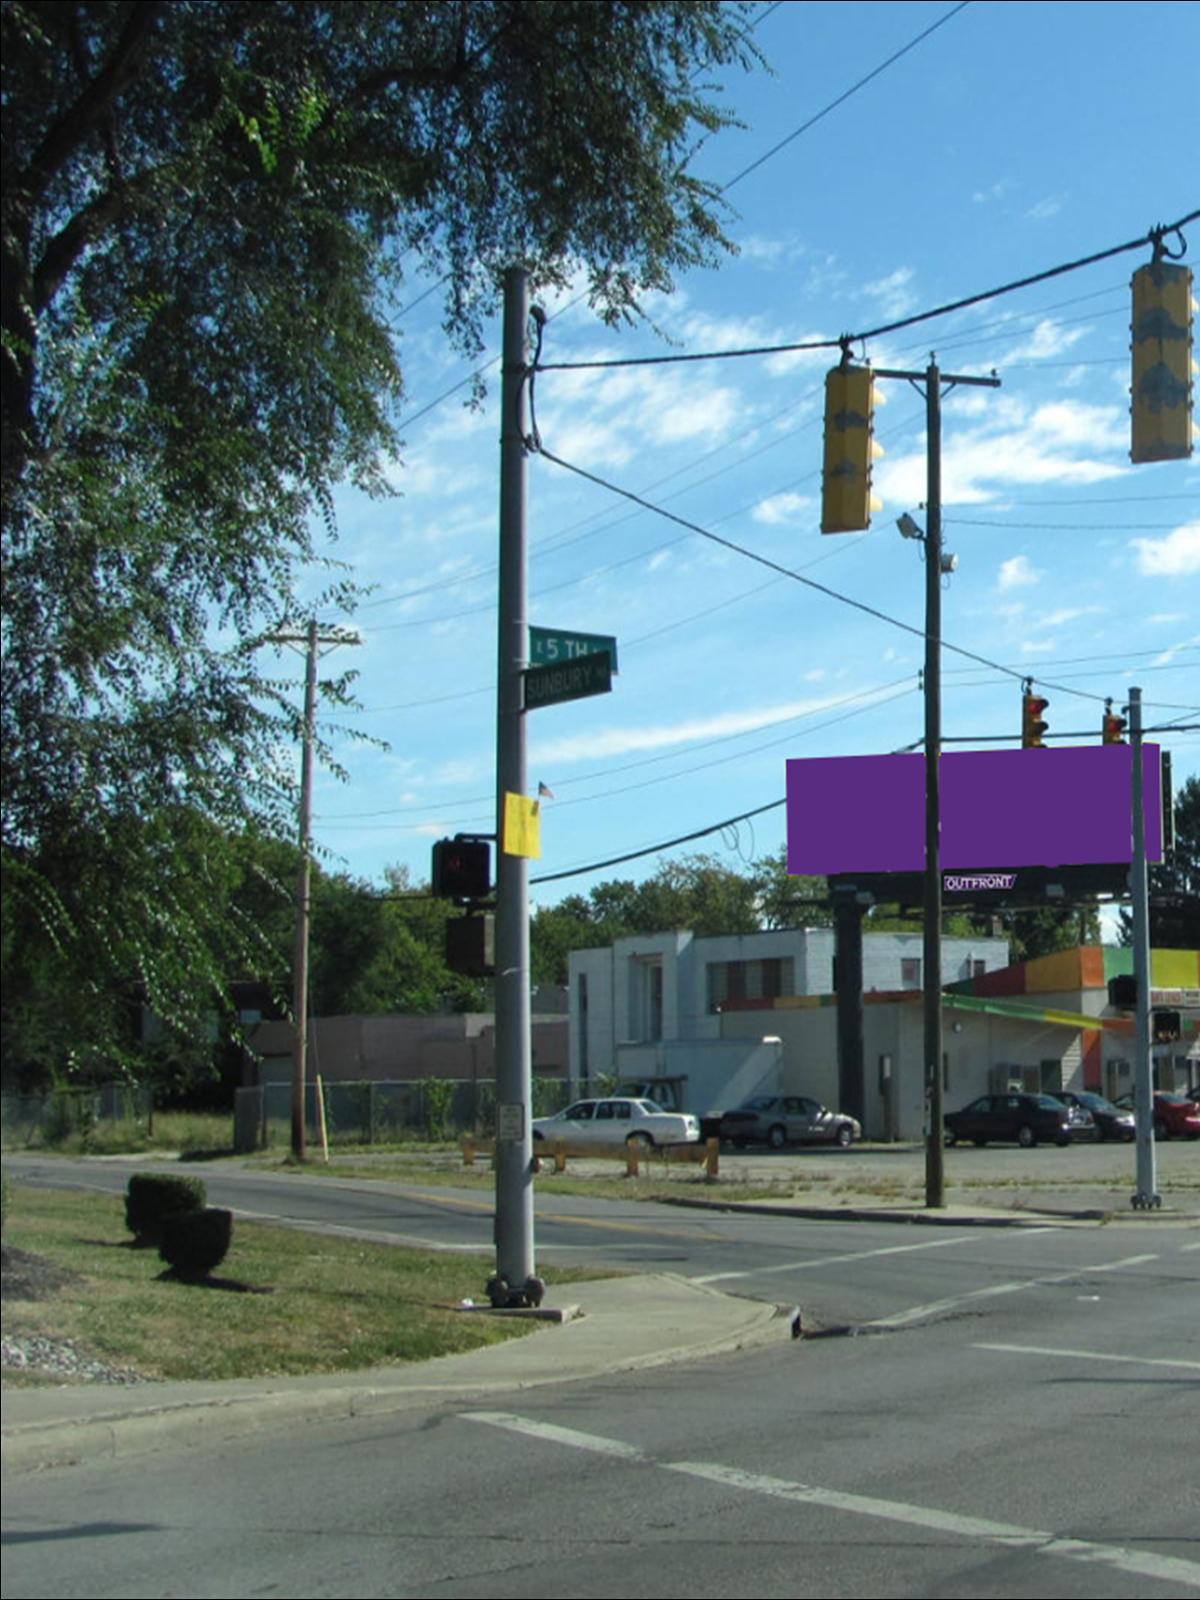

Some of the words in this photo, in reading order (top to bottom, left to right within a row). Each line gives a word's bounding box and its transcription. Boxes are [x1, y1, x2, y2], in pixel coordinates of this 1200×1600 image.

[547, 639, 559, 659] 5
[564, 640, 588, 659] TH
[527, 666, 593, 699] SUNBURY
[946, 875, 1013, 890] OUTFRONT
